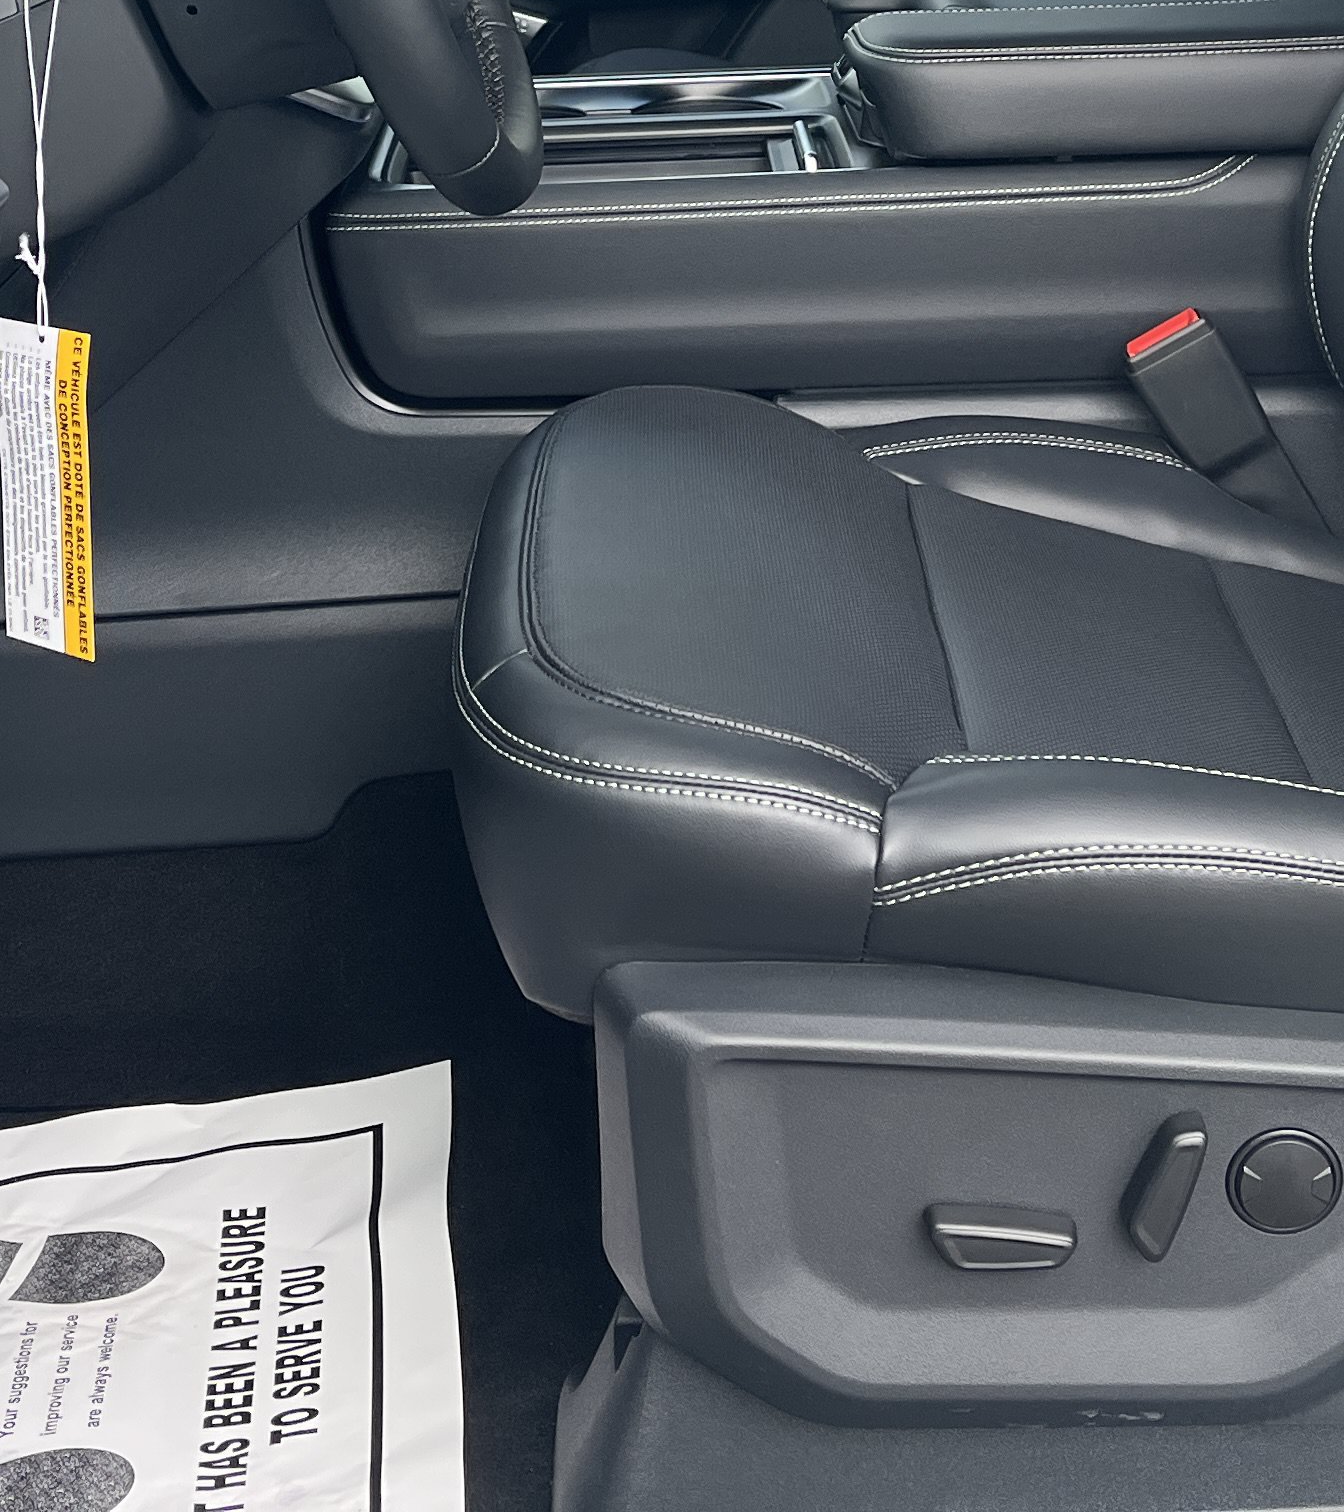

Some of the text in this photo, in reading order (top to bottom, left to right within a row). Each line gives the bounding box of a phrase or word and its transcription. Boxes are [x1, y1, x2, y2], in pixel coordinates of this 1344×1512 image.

[74, 337, 83, 356] CE
[58, 379, 68, 399] DE
[71, 361, 83, 428] VÉHICULE
[58, 403, 72, 491] CONCEPTION
[73, 433, 82, 458] EST
[75, 503, 84, 523] DE
[76, 526, 85, 561] SACS
[77, 565, 88, 654] GONFLABLES
[213, 1206, 267, 1330] PLEASURE
[19, 1321, 38, 1336] for
[210, 1334, 258, 1351] A
[269, 1265, 326, 1446] TO SERVE YOU
[8, 1338, 34, 1404] suggestions
[40, 1314, 78, 1436] improving our service
[87, 1314, 118, 1428] are always welcome.
[202, 1360, 256, 1429] BEEN
[195, 1437, 251, 1492] HAS
